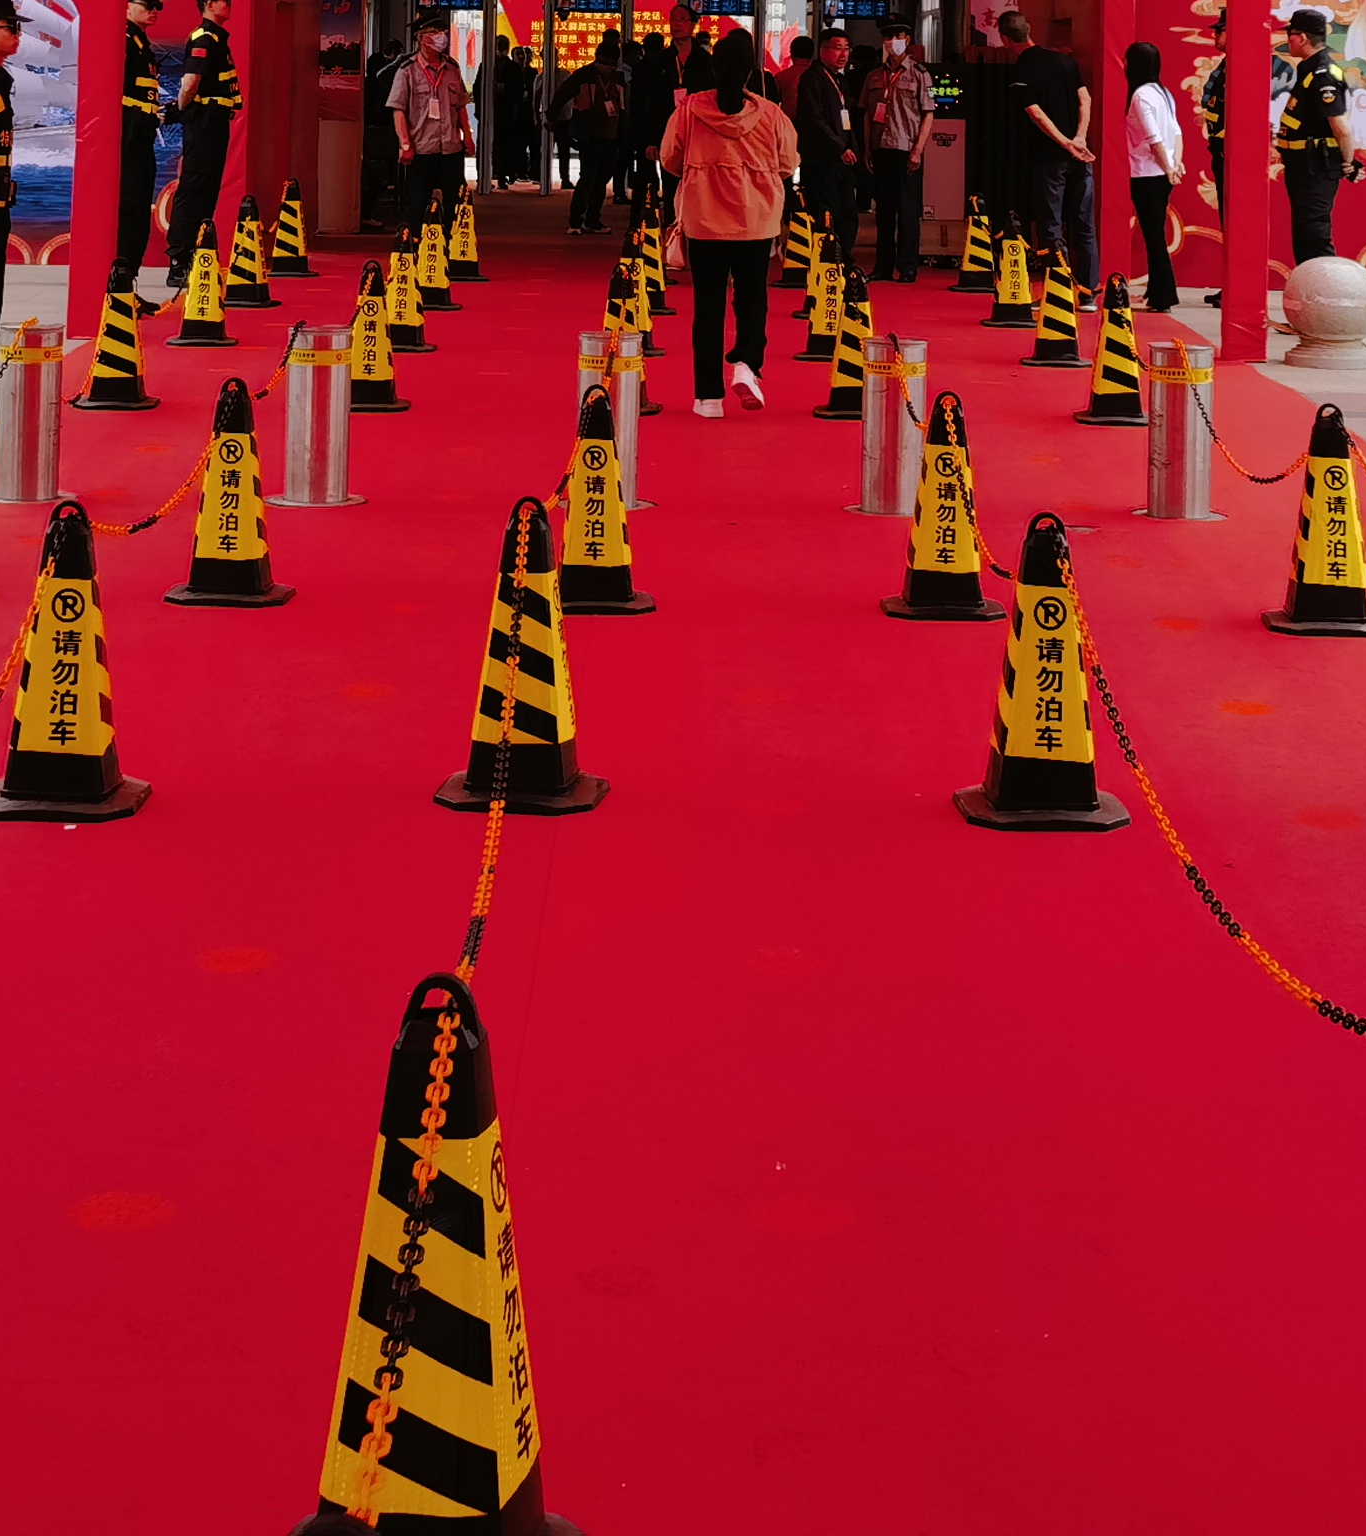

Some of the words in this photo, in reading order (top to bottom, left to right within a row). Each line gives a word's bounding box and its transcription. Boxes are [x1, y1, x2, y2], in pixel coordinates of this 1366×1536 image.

[196, 269, 211, 317] 请勿泊车
[394, 274, 408, 322] 请勿泊车
[824, 284, 837, 333] 请勿泊车
[1009, 258, 1021, 301] 请勿泊车
[362, 320, 377, 376] 请勿泊车
[216, 468, 241, 554] 请勿泊车
[584, 475, 606, 561] 请勿泊车
[935, 480, 958, 566] 请勿泊车
[1325, 495, 1349, 581] 请勿泊车
[47, 628, 83, 748] 请勿泊车
[1035, 637, 1066, 754] 请勿泊车
[496, 1222, 536, 1462] 请勿泊车
